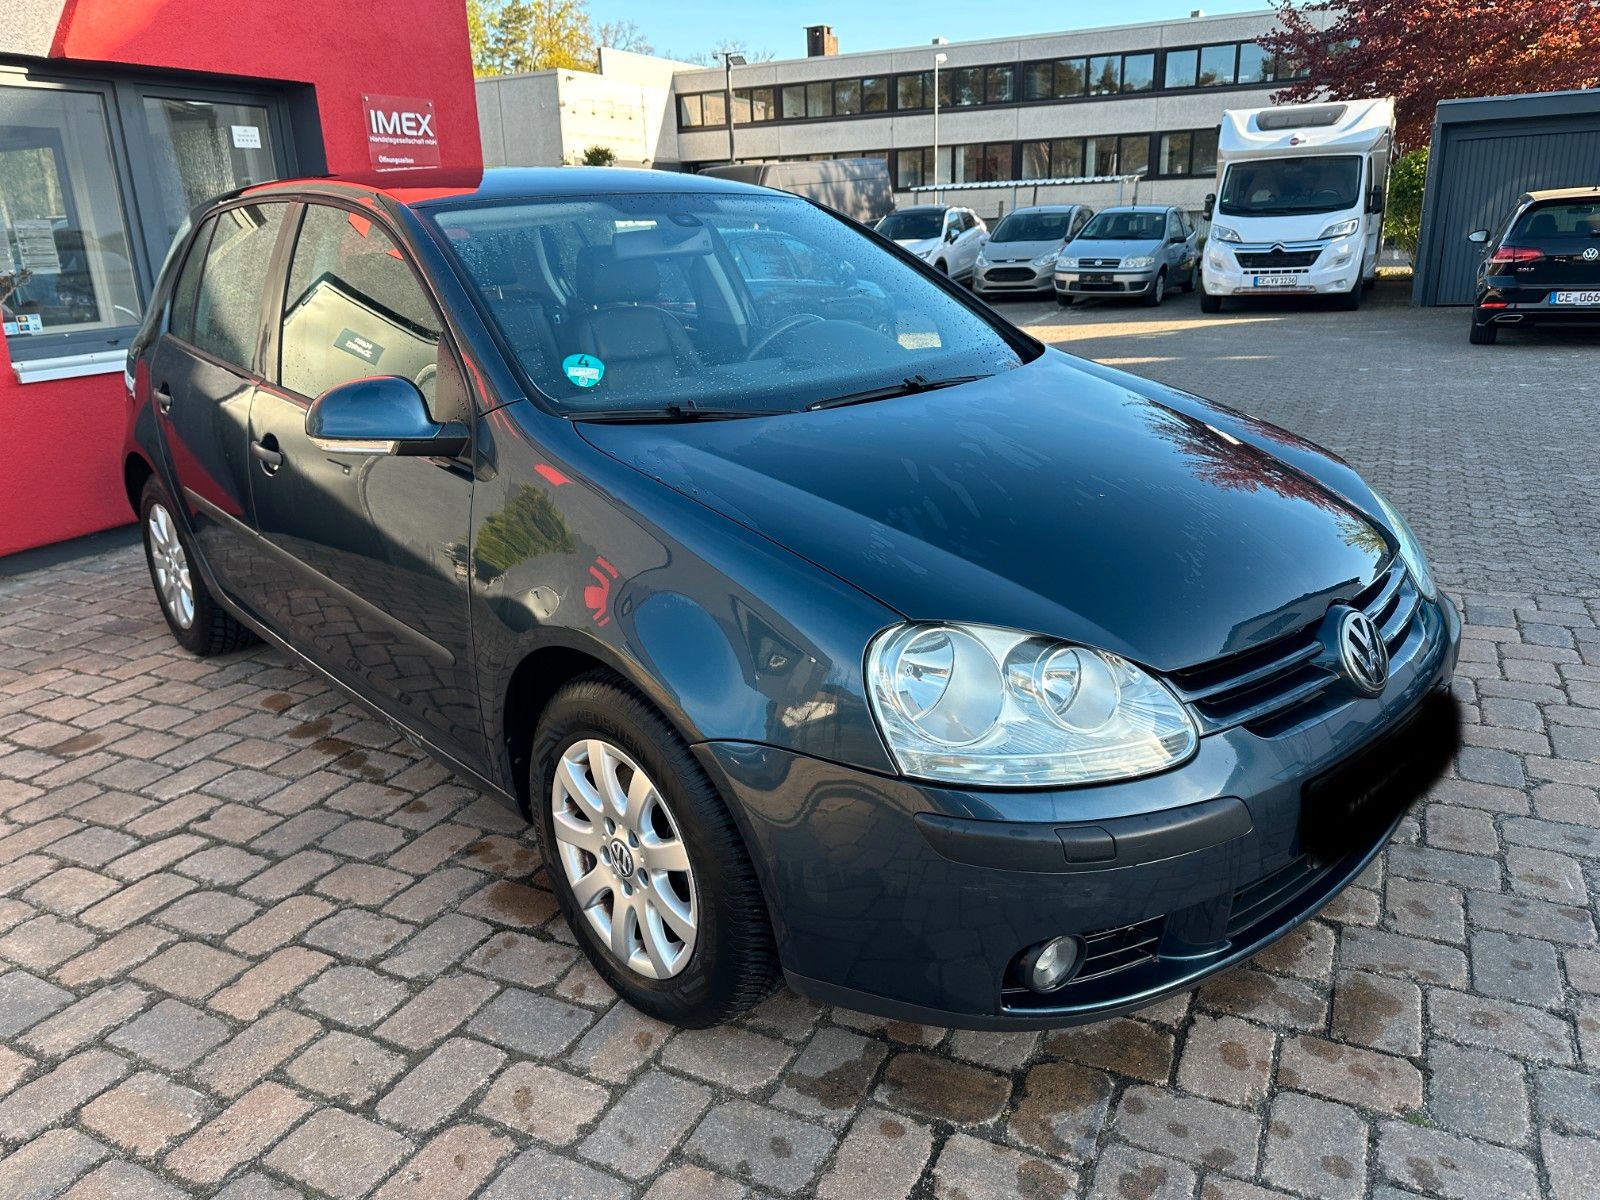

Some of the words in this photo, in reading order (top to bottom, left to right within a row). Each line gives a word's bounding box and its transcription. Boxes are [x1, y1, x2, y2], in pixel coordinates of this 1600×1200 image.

[369, 109, 434, 136] IMEX
[1557, 292, 1572, 302] CE
[577, 354, 589, 367] 4
